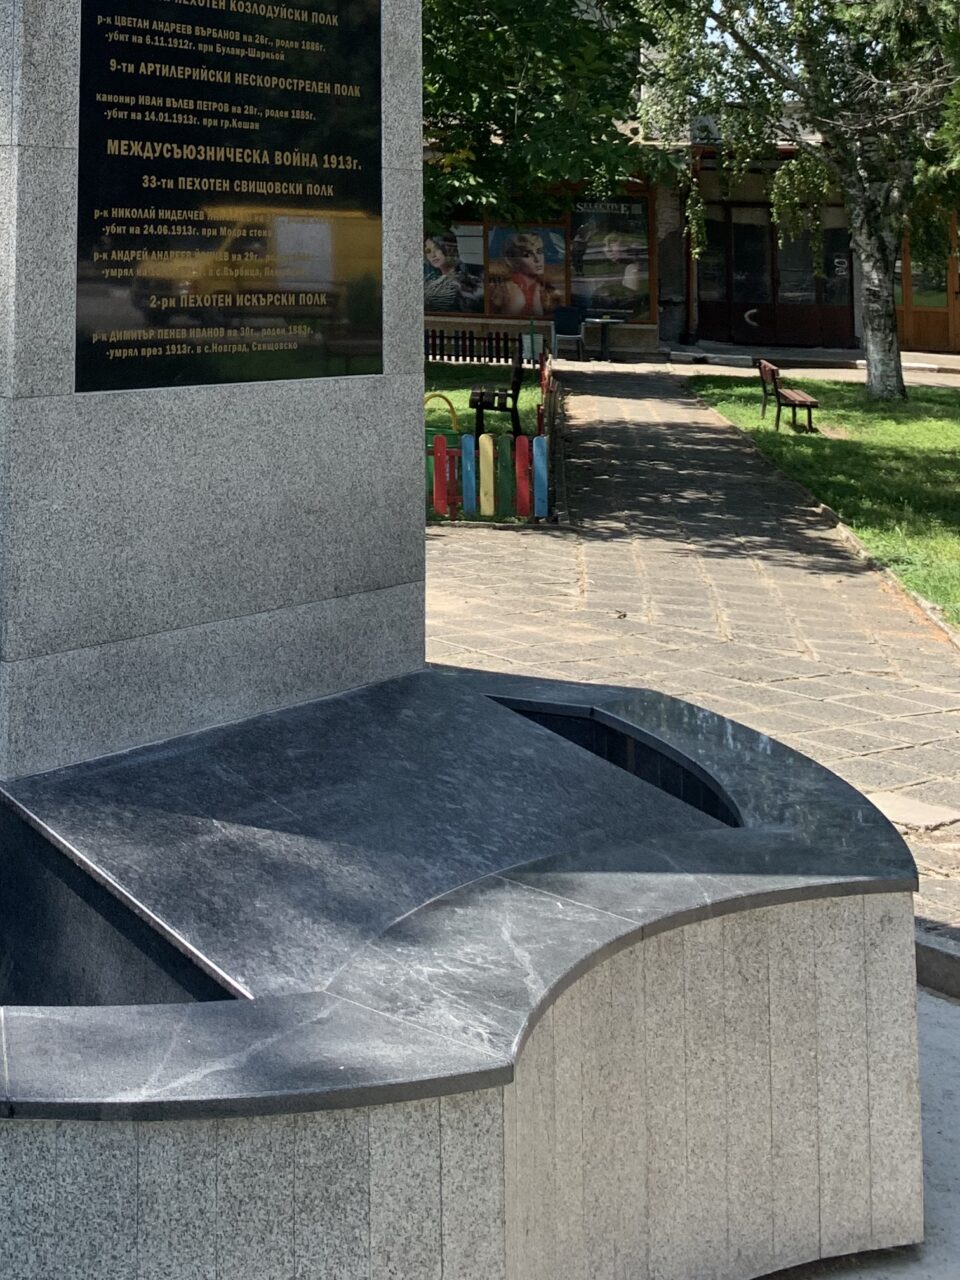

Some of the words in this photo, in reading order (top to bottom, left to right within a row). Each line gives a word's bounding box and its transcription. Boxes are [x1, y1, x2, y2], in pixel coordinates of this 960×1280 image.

[311, 12, 337, 26] ПОЛК
[114, 15, 149, 30] ЦВЕТАН
[151, 20, 192, 35] АНДРЕЕВ
[194, 26, 240, 40] ВЪРБАНОВ
[109, 58, 134, 72] 9-ти
[139, 59, 230, 82] АРТИЛЕРИЙСКИ
[234, 72, 330, 93] НЕСКОРОСТРЕЛЕН
[334, 84, 360, 96] ПОЛК
[138, 95, 162, 106] ИВАН
[165, 97, 194, 109] ВЪЛЕВ
[196, 100, 229, 112] ПЕТРОВ
[107, 139, 269, 165] МЕЖДУСЪЮЗНИЧЕСКА
[274, 148, 317, 167] ВОЙНА
[323, 154, 361, 170] 1913г.
[142, 175, 173, 188] 33-ти
[178, 177, 229, 190] ПЕХОТЕН
[233, 180, 302, 196] СВИЩОВСКИ
[306, 184, 333, 195] ПОЛК
[111, 205, 155, 218] НИКОЛАЙ
[110, 248, 148, 261] АНДРЕЙ
[149, 295, 175, 309] 2-ри
[180, 294, 231, 306] ПЕХОТЕН
[236, 294, 295, 305] ИСКЪРСКИ
[299, 294, 326, 305] ПОЛК
[109, 329, 155, 342] ДИМИТЪР
[157, 329, 187, 339] ПЕНЕВ
[189, 328, 224, 338] ИВАНОВ
